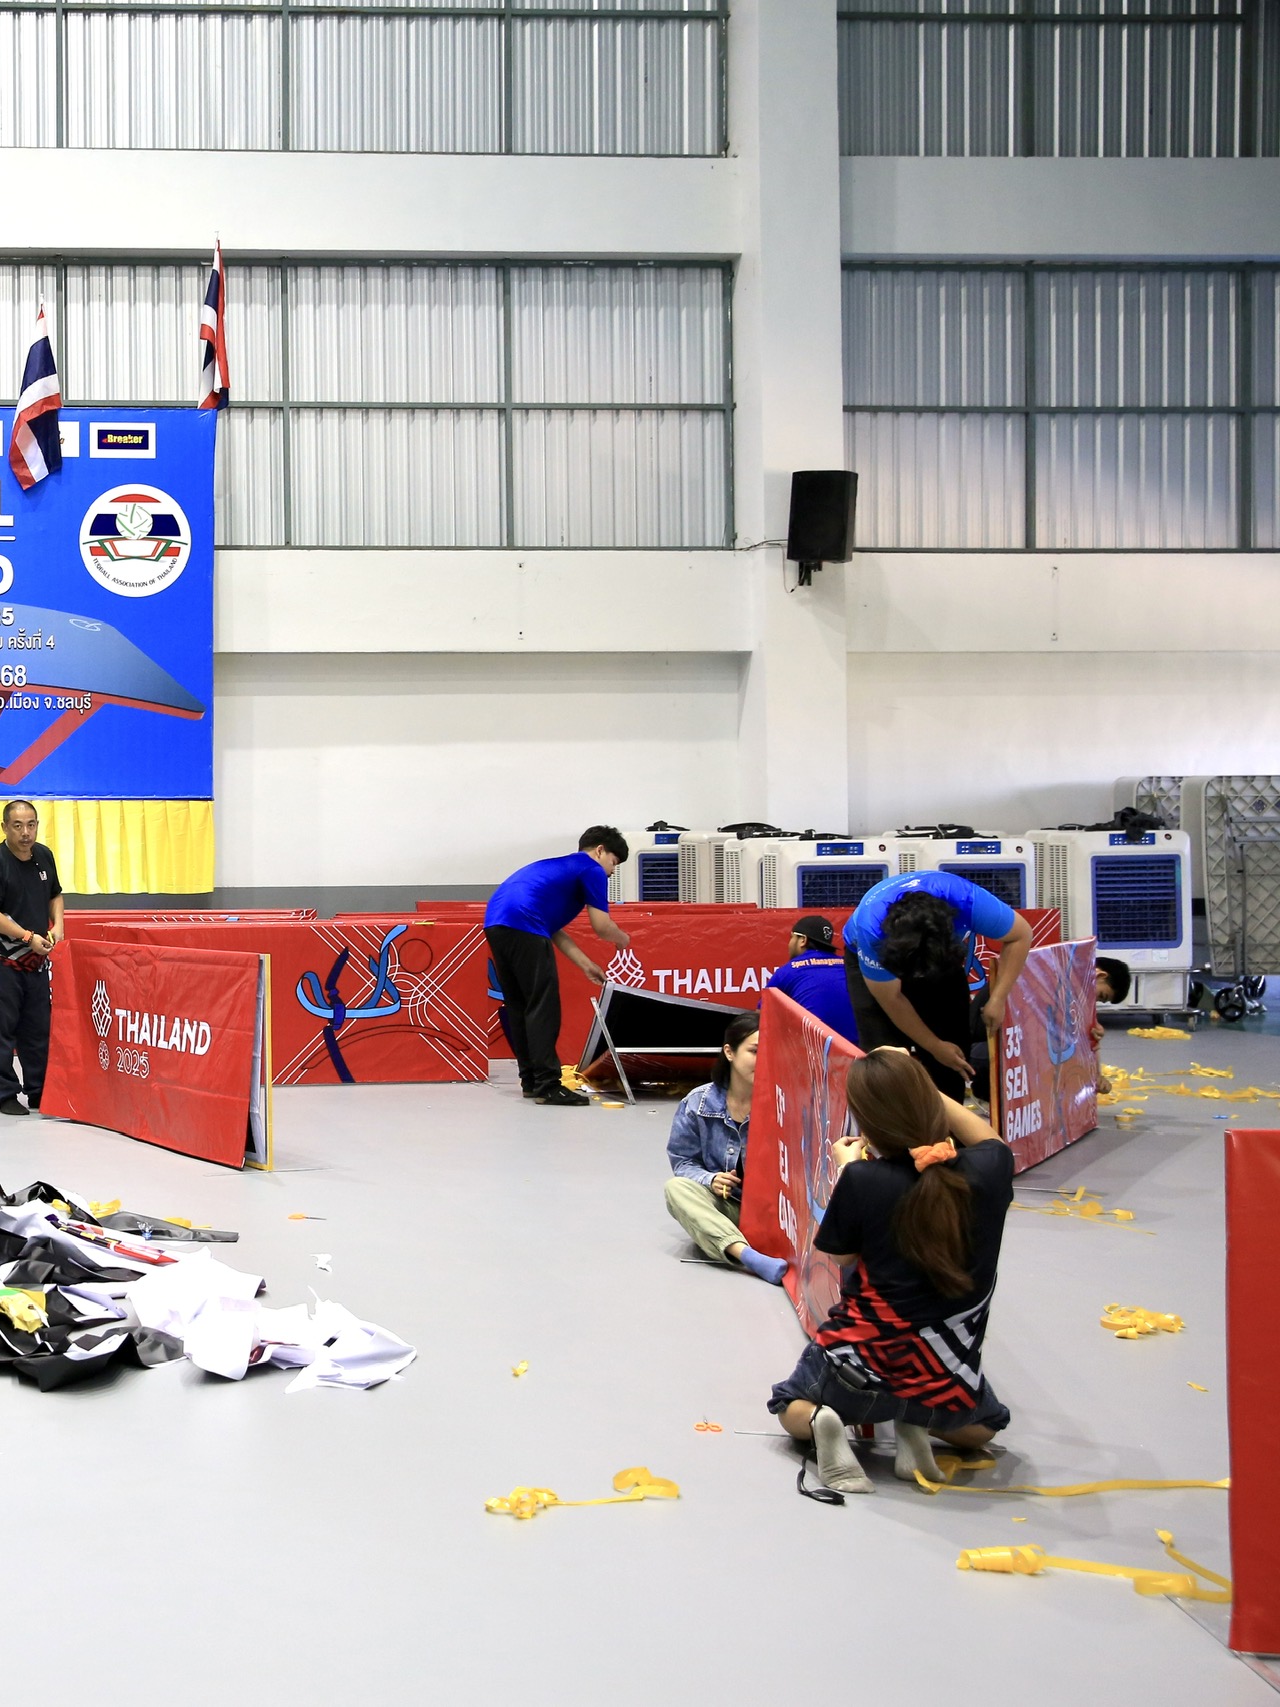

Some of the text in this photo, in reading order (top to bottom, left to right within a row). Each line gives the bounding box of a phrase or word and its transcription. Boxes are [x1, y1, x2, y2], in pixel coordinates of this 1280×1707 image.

[107, 434, 144, 444] Breaker
[112, 577, 148, 588] ASSOCIATION
[157, 557, 178, 581] THAILAND
[8, 628, 42, 650] ครั้งที่
[46, 635, 56, 649] 4
[44, 692, 92, 715] จ.ชลบุรี
[791, 959, 809, 969] Sport
[115, 1008, 212, 1056] THAILAND
[116, 1047, 150, 1079] 2025
[1006, 1064, 1029, 1101] SEA
[1006, 1099, 1042, 1143] GAMES
